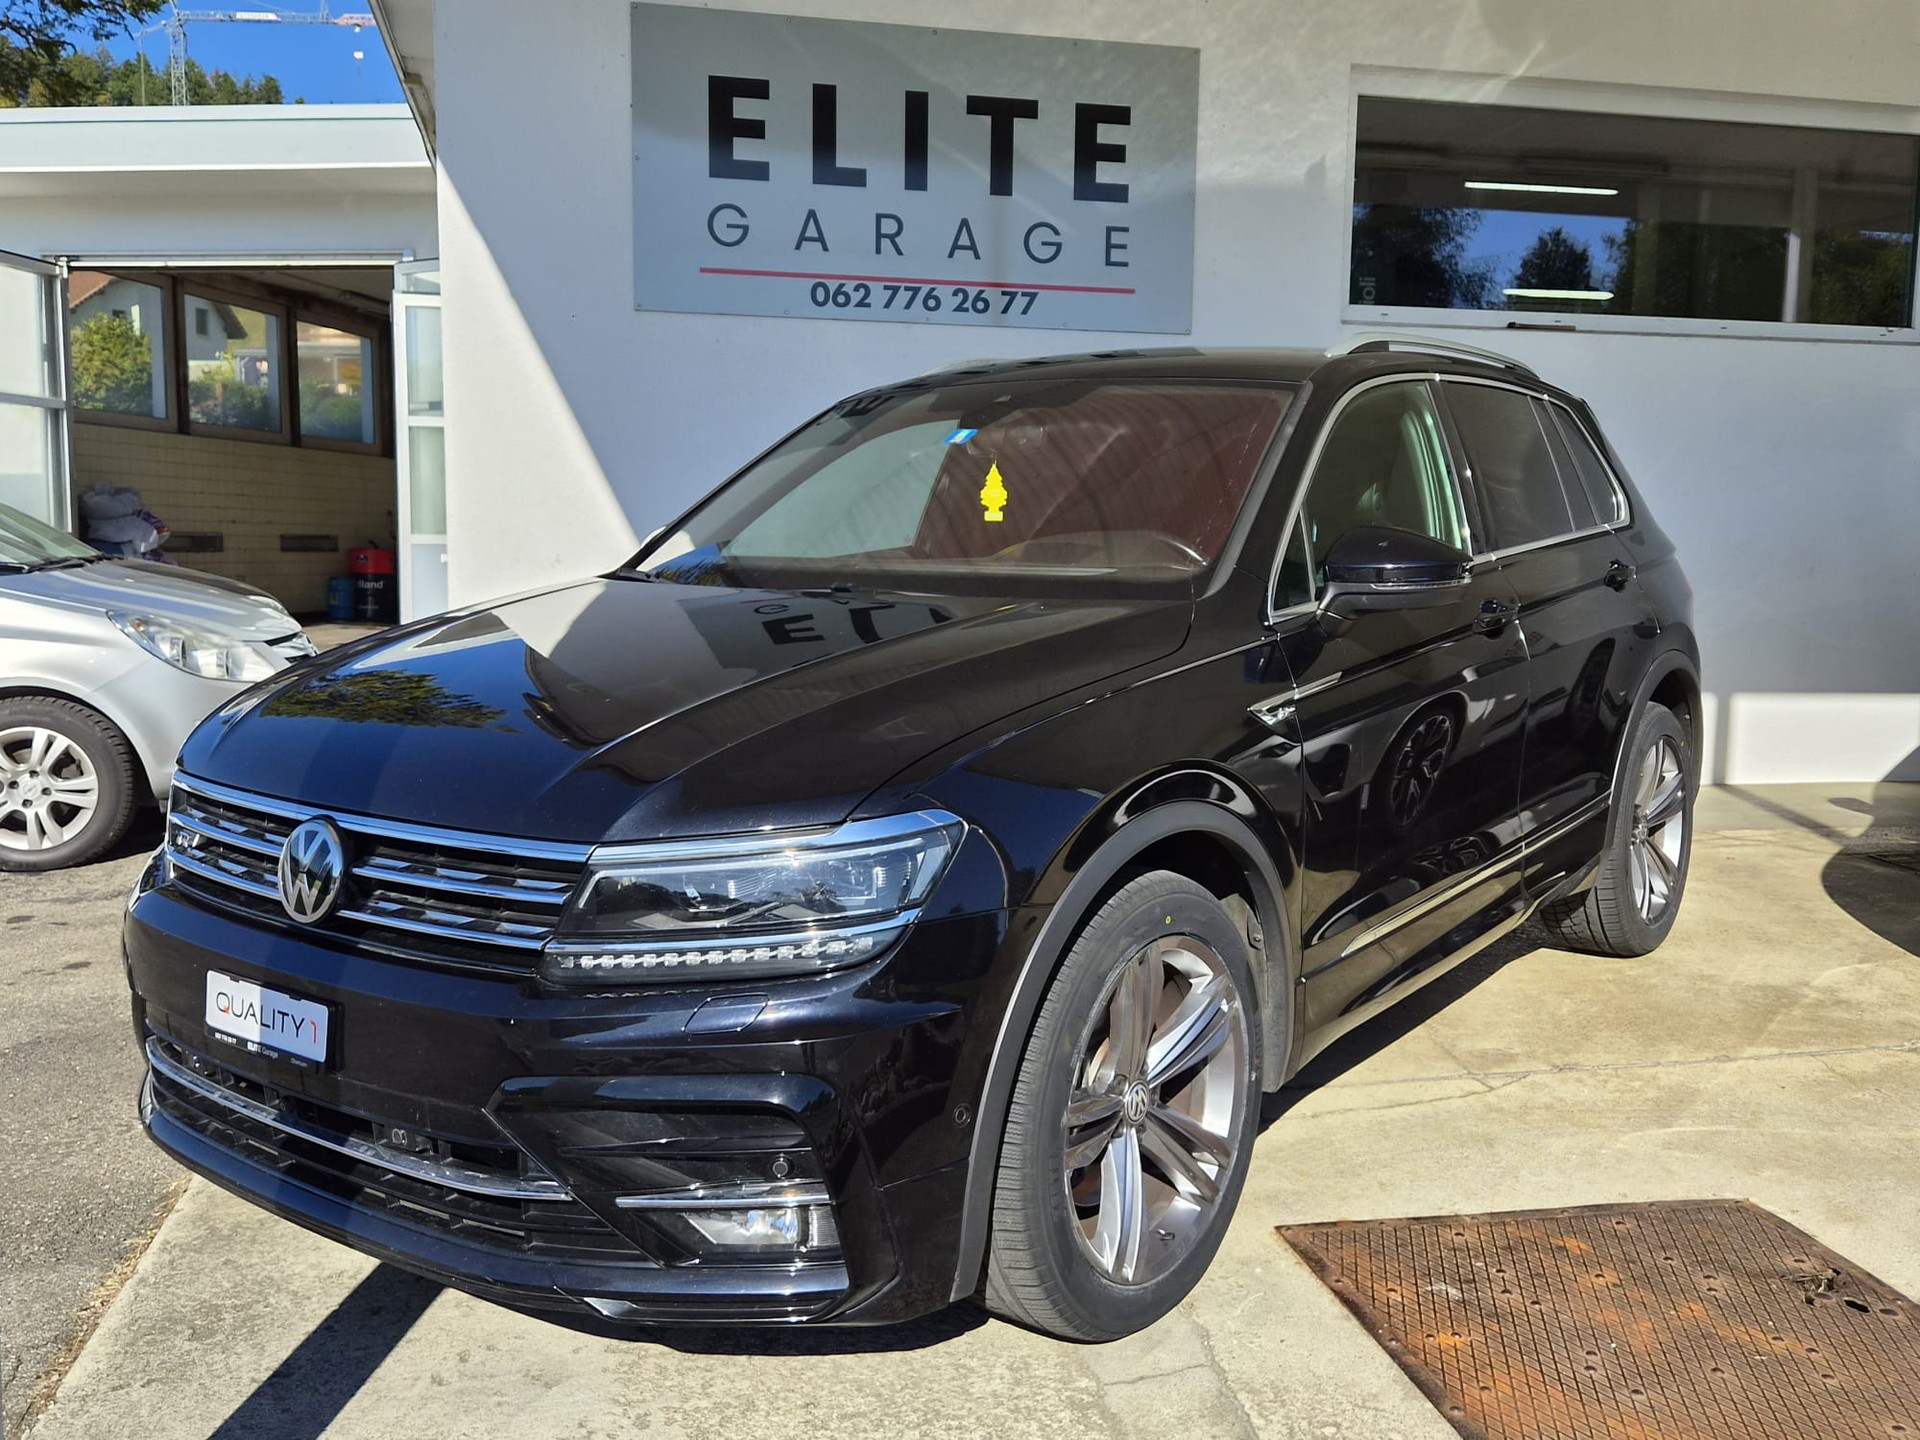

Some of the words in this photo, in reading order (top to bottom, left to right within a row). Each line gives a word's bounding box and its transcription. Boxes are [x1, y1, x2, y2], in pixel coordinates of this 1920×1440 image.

[708, 75, 1131, 203] ELITE
[707, 203, 1129, 267] GARAGE
[810, 281, 871, 308] 062
[883, 285, 942, 312] 776
[952, 287, 990, 314] 26
[1000, 290, 1039, 316] 77
